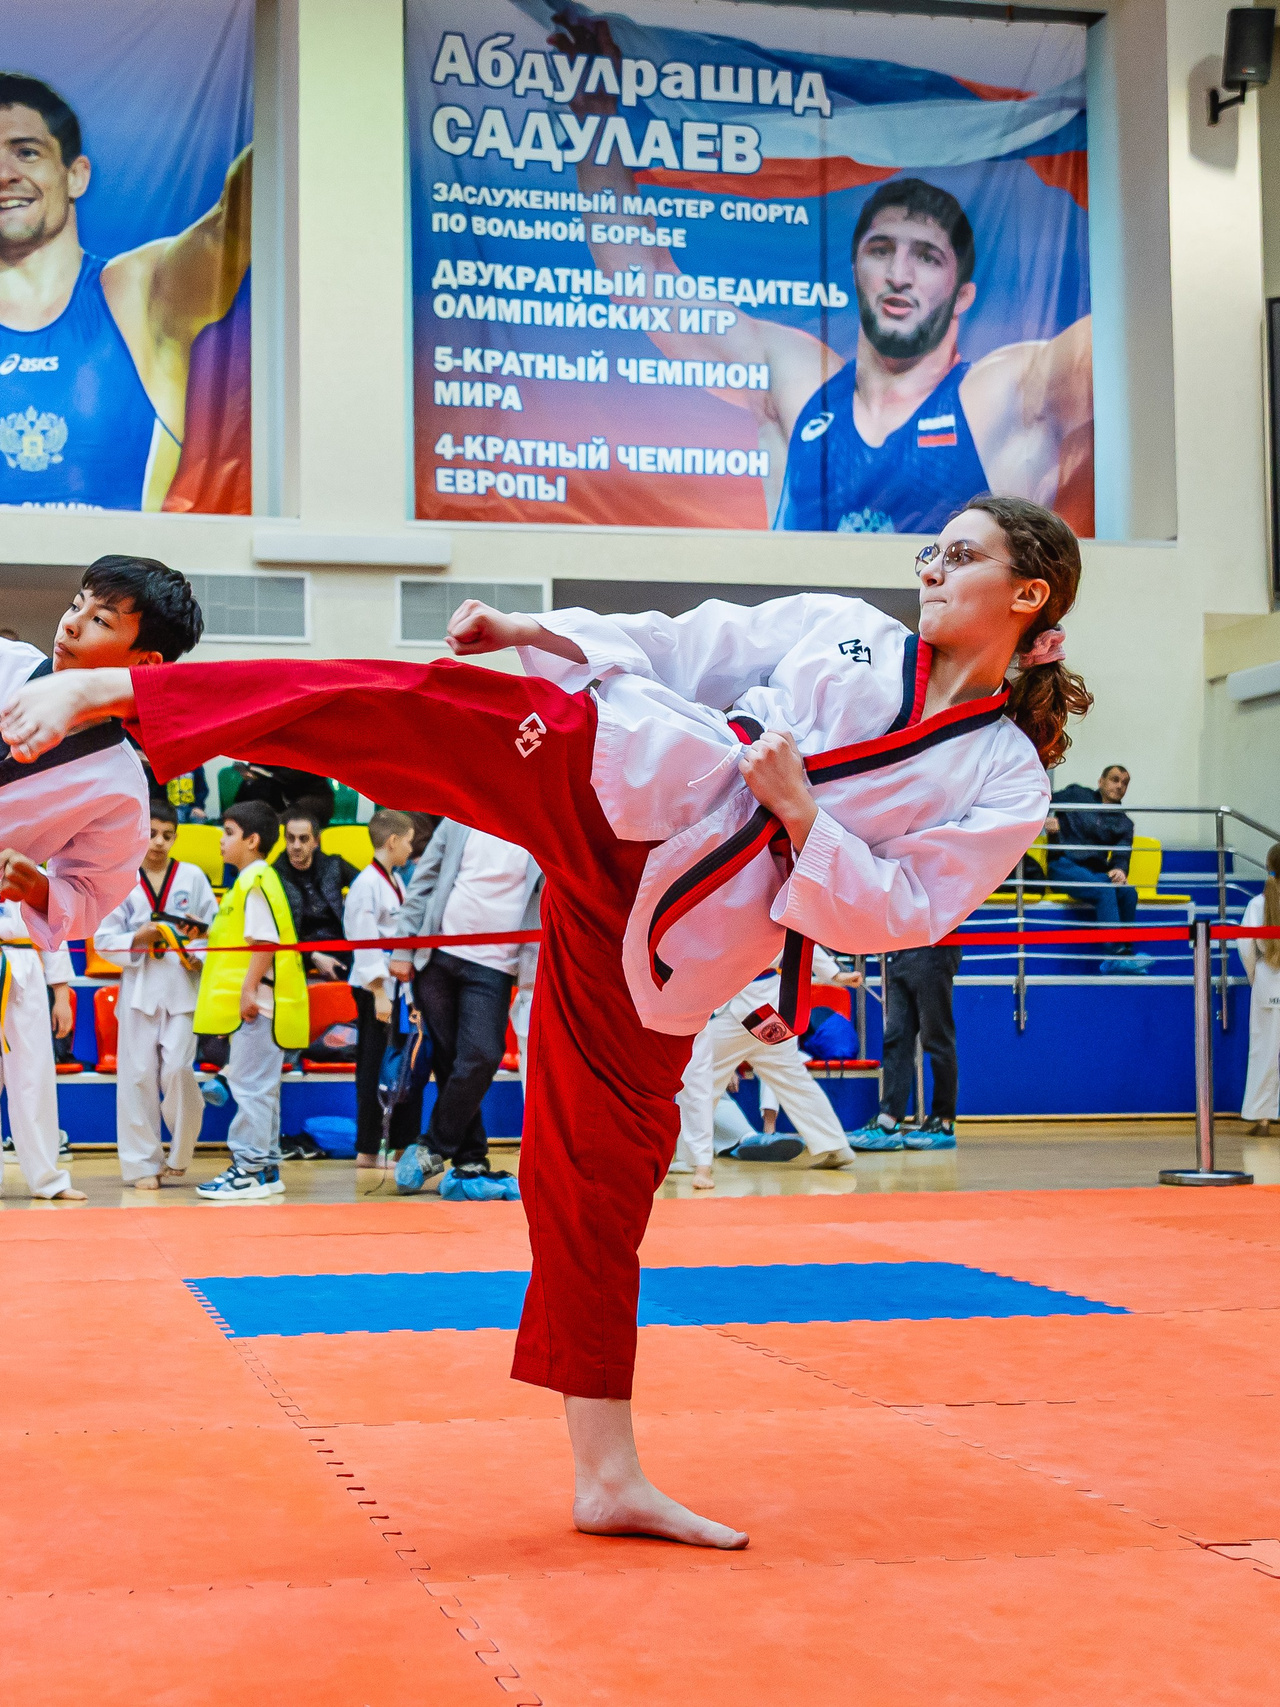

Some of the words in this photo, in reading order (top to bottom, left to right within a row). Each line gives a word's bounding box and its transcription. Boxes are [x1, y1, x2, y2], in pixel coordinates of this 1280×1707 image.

[432, 32, 831, 117] Абдулрашид
[432, 105, 762, 174] САДУЛАЕВ
[433, 182, 617, 214] ЗАСЛУЖЕННЫЙ
[622, 194, 715, 219] МАСТЕР
[720, 201, 809, 225] СПОРТА
[432, 212, 467, 233] ПО
[472, 216, 586, 243] ВОЛЬНОЙ
[591, 224, 687, 248] БОРЬБЕ
[431, 259, 646, 298] ДВУКРАТНЫЙ
[654, 273, 849, 308] ПОБЕДИТЕЛЬ
[433, 292, 671, 332] ОЛИМПИЙСКИХ
[679, 306, 737, 335] ИГР
[433, 345, 609, 383] 5-КРАТНЫЙ
[617, 357, 769, 389] ЧЕМПИОН
[433, 380, 523, 411] МИРА
[434, 432, 610, 470] 4-КРАТНЫЙ
[617, 445, 769, 477] ЧЕМПИОН
[435, 467, 567, 502] ЕВРОПЫ
